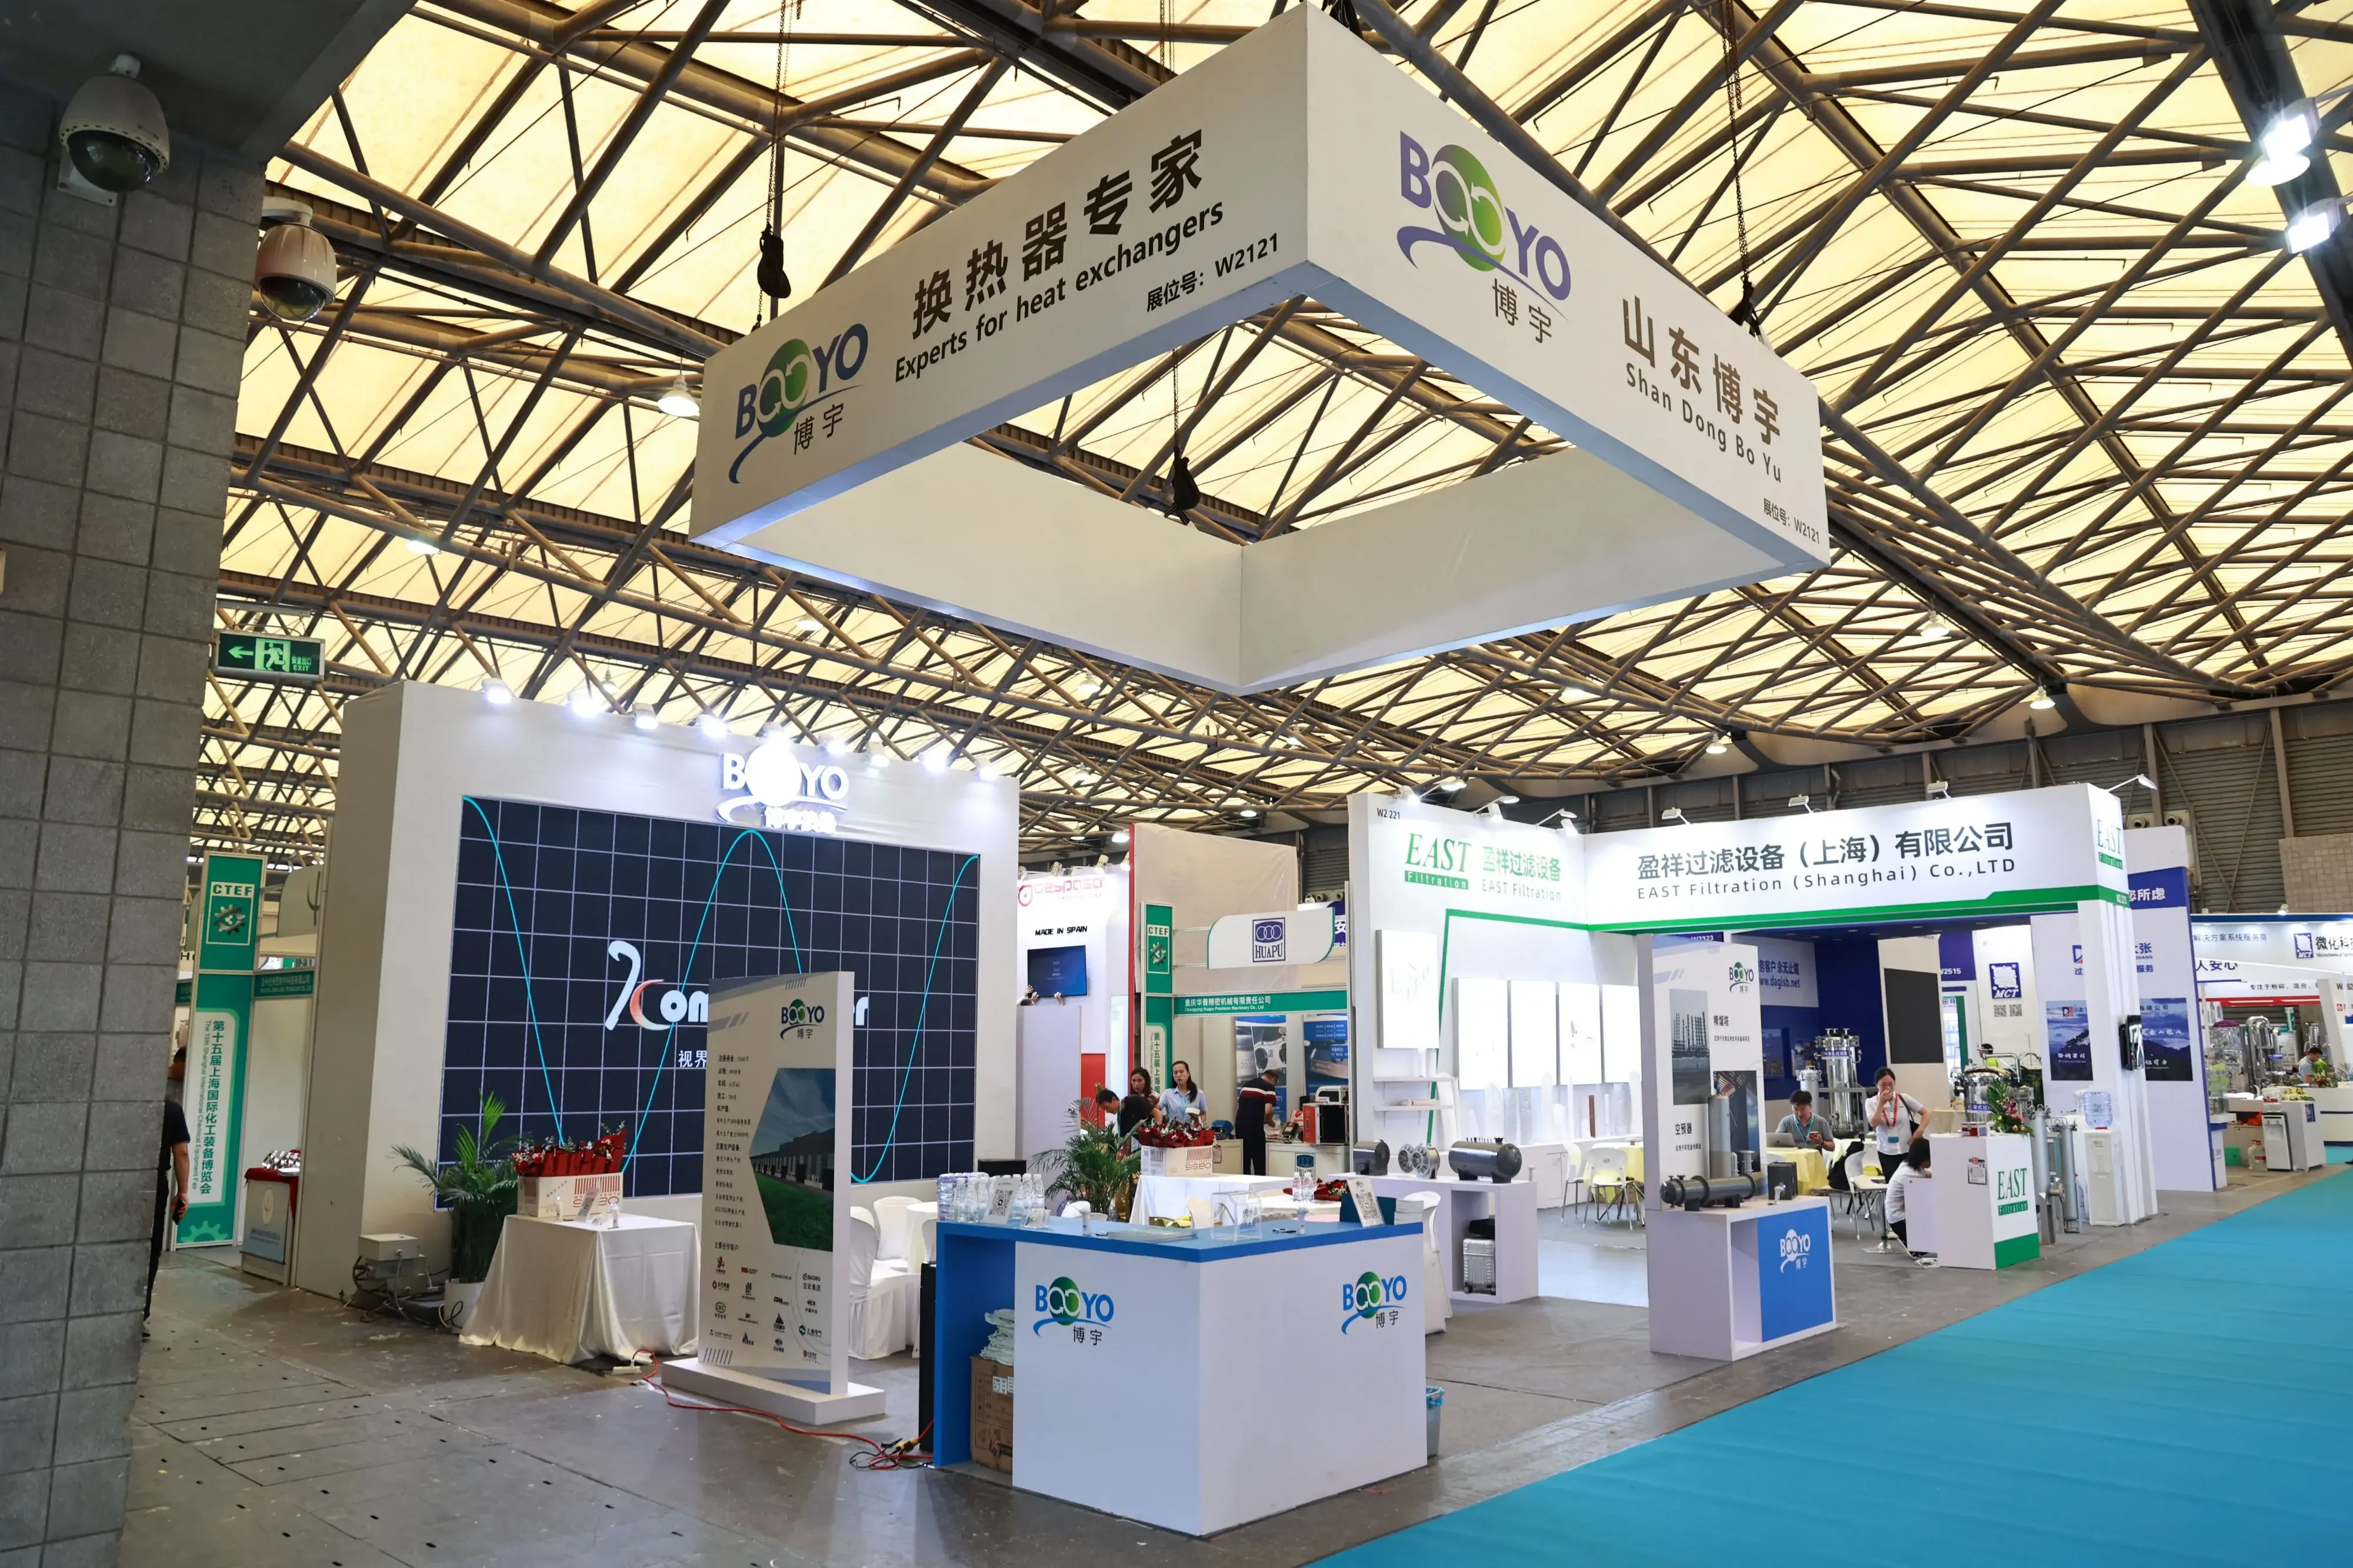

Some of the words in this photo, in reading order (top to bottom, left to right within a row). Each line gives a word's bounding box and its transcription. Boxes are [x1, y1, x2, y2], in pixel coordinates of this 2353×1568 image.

[912, 129, 1202, 340] 换热器专家
[1214, 233, 1279, 279] W2121
[895, 332, 968, 382] Experts
[976, 308, 1008, 342] for
[1016, 278, 1066, 322] heat
[1075, 201, 1223, 292] exchangers
[1492, 278, 1552, 343] 博宇
[1622, 296, 1780, 445] 山东博宇
[794, 403, 844, 455] 博宇
[1627, 363, 1672, 412] Shan
[1682, 399, 1726, 452] Dong
[1736, 435, 1755, 465] Bo
[1762, 453, 1781, 483] Yu
[1794, 516, 1820, 545] W2121
[292, 657, 311, 665] 安全出口
[2097, 819, 2121, 853] EAST
[1405, 833, 1471, 873] EAST
[212, 885, 253, 896] CTEF
[1407, 872, 1467, 889] Filtration
[1482, 879, 1508, 895] EAST
[1513, 883, 1561, 902] Filtration
[1637, 886, 1681, 899] EAST
[1689, 878, 1782, 896] Filtration
[1793, 865, 1918, 890] (Shanghai)
[1148, 926, 1169, 935] CTEF
[1255, 943, 1283, 959] HUAPU
[1185, 996, 1271, 1007] 重庆华普精密机械有限责任公司
[1994, 989, 2019, 998] MCT
[797, 1028, 812, 1039] 博宇
[200, 1020, 225, 1195] 第十五届上海国际化工装备博览会
[193, 1144, 201, 1177] Equipment
[1998, 1167, 2027, 1200] EAST
[1999, 1203, 2027, 1215] Filtration
[1780, 1233, 1811, 1257] BOOYO
[1796, 1258, 1807, 1270] 博宇
[1035, 1284, 1114, 1323] BOOYO
[1342, 1274, 1407, 1312] BOOYO
[1375, 1309, 1400, 1329] 博宇
[1073, 1326, 1103, 1346] 博宇
